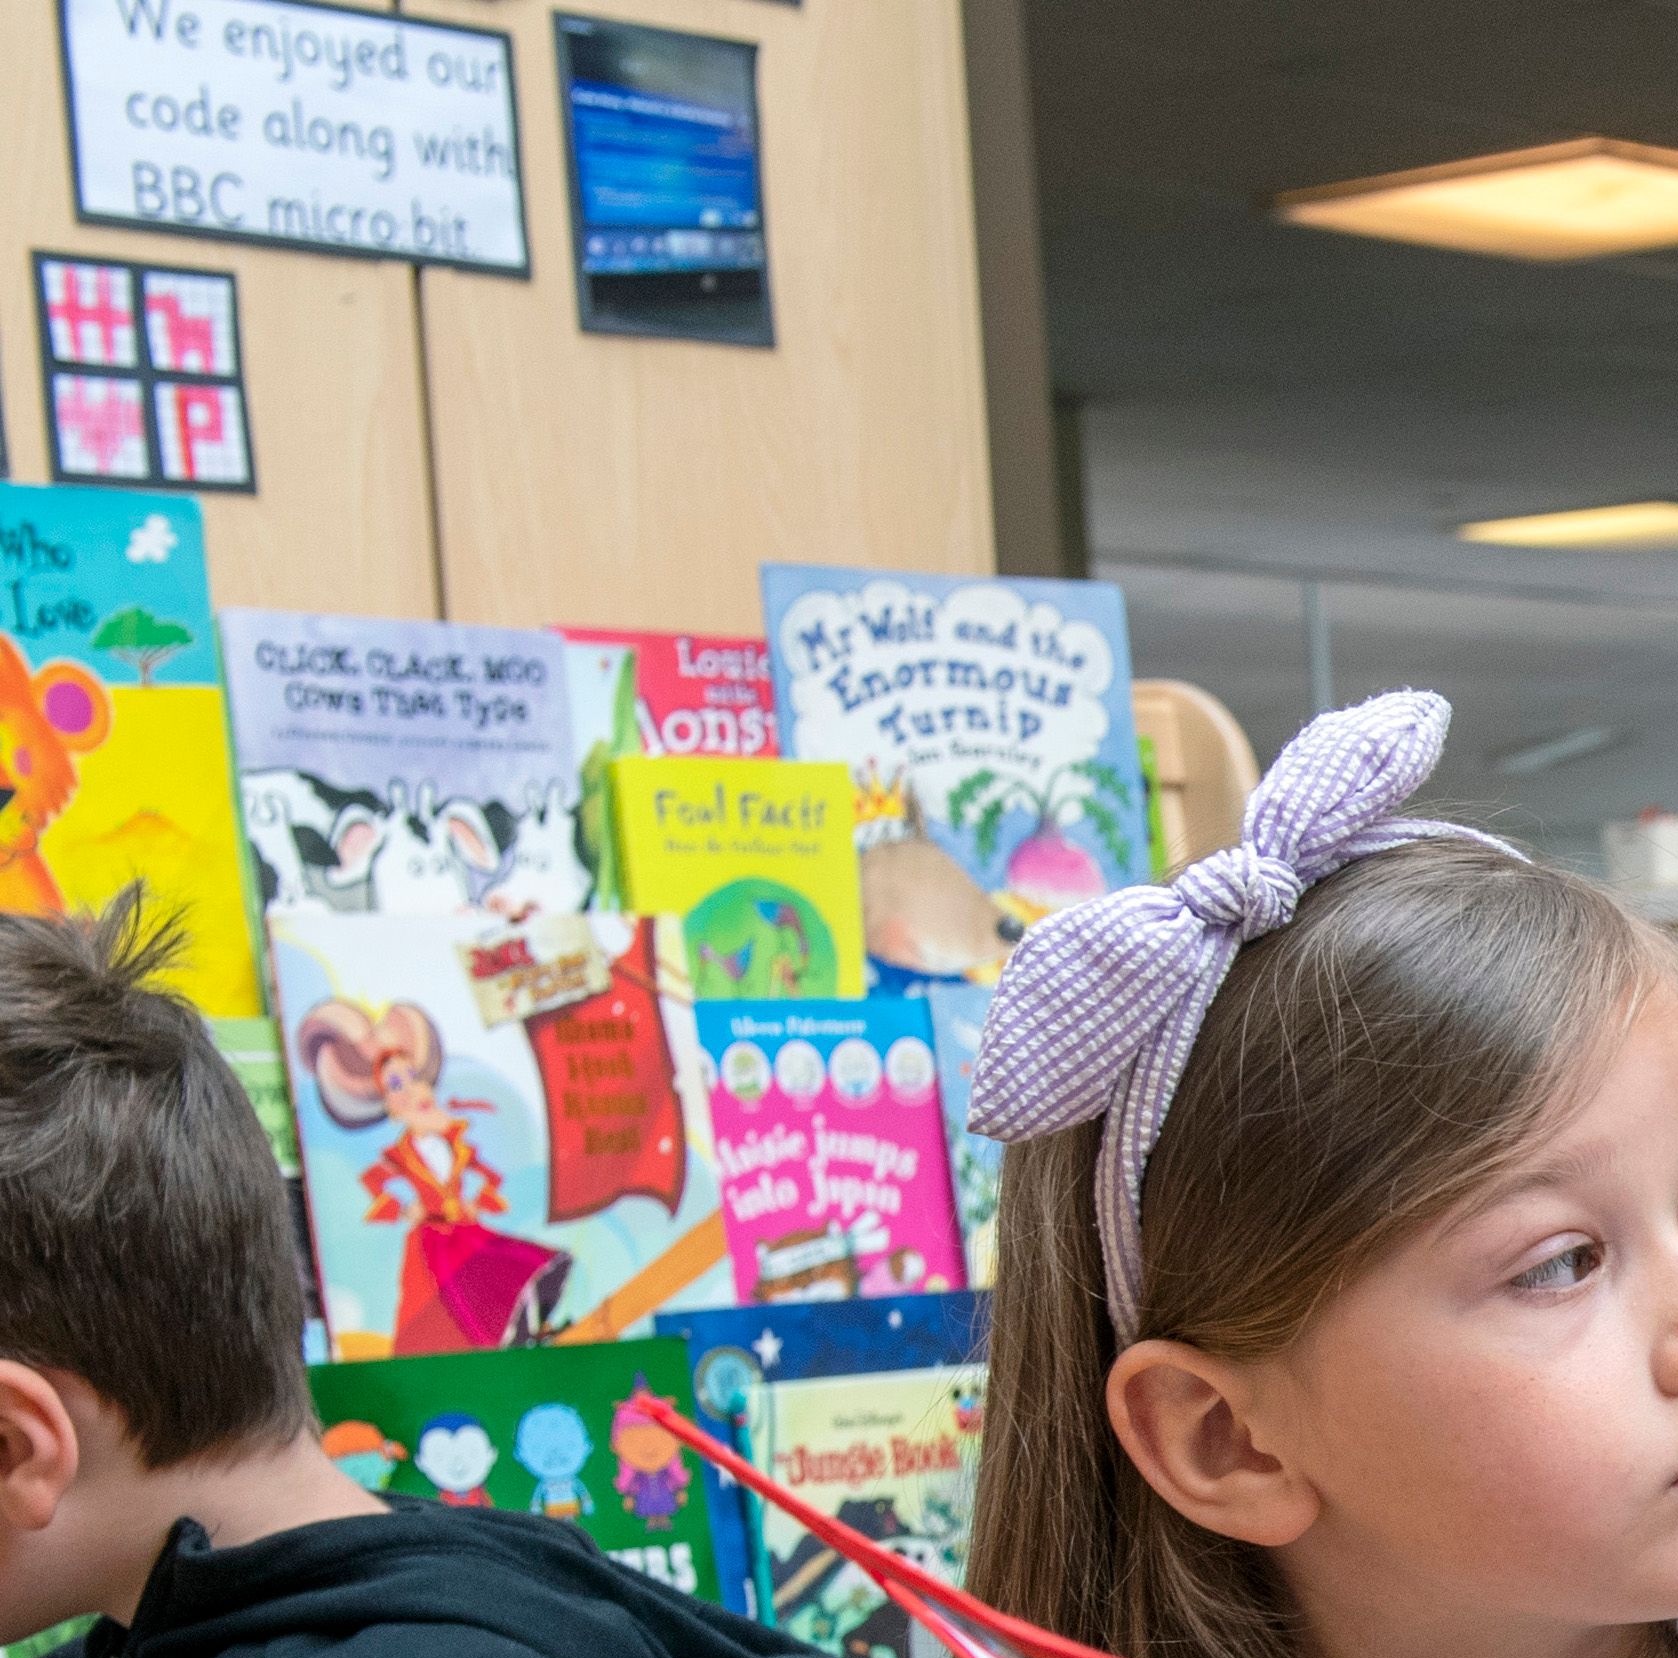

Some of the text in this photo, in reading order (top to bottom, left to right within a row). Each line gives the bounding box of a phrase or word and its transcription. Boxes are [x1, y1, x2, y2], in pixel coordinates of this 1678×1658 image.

[118, 0, 501, 94] We enjoyed our
[124, 83, 516, 182] code along with
[130, 159, 245, 227] BBC
[800, 605, 1086, 671] Mr Wolf and the
[481, 654, 547, 687] MOO
[828, 659, 1074, 713] Enormous
[879, 698, 1042, 746] Turnip
[807, 1112, 920, 1182] jumps
[726, 1165, 902, 1222] into Japan
[787, 1433, 961, 1490] Jungle Book
